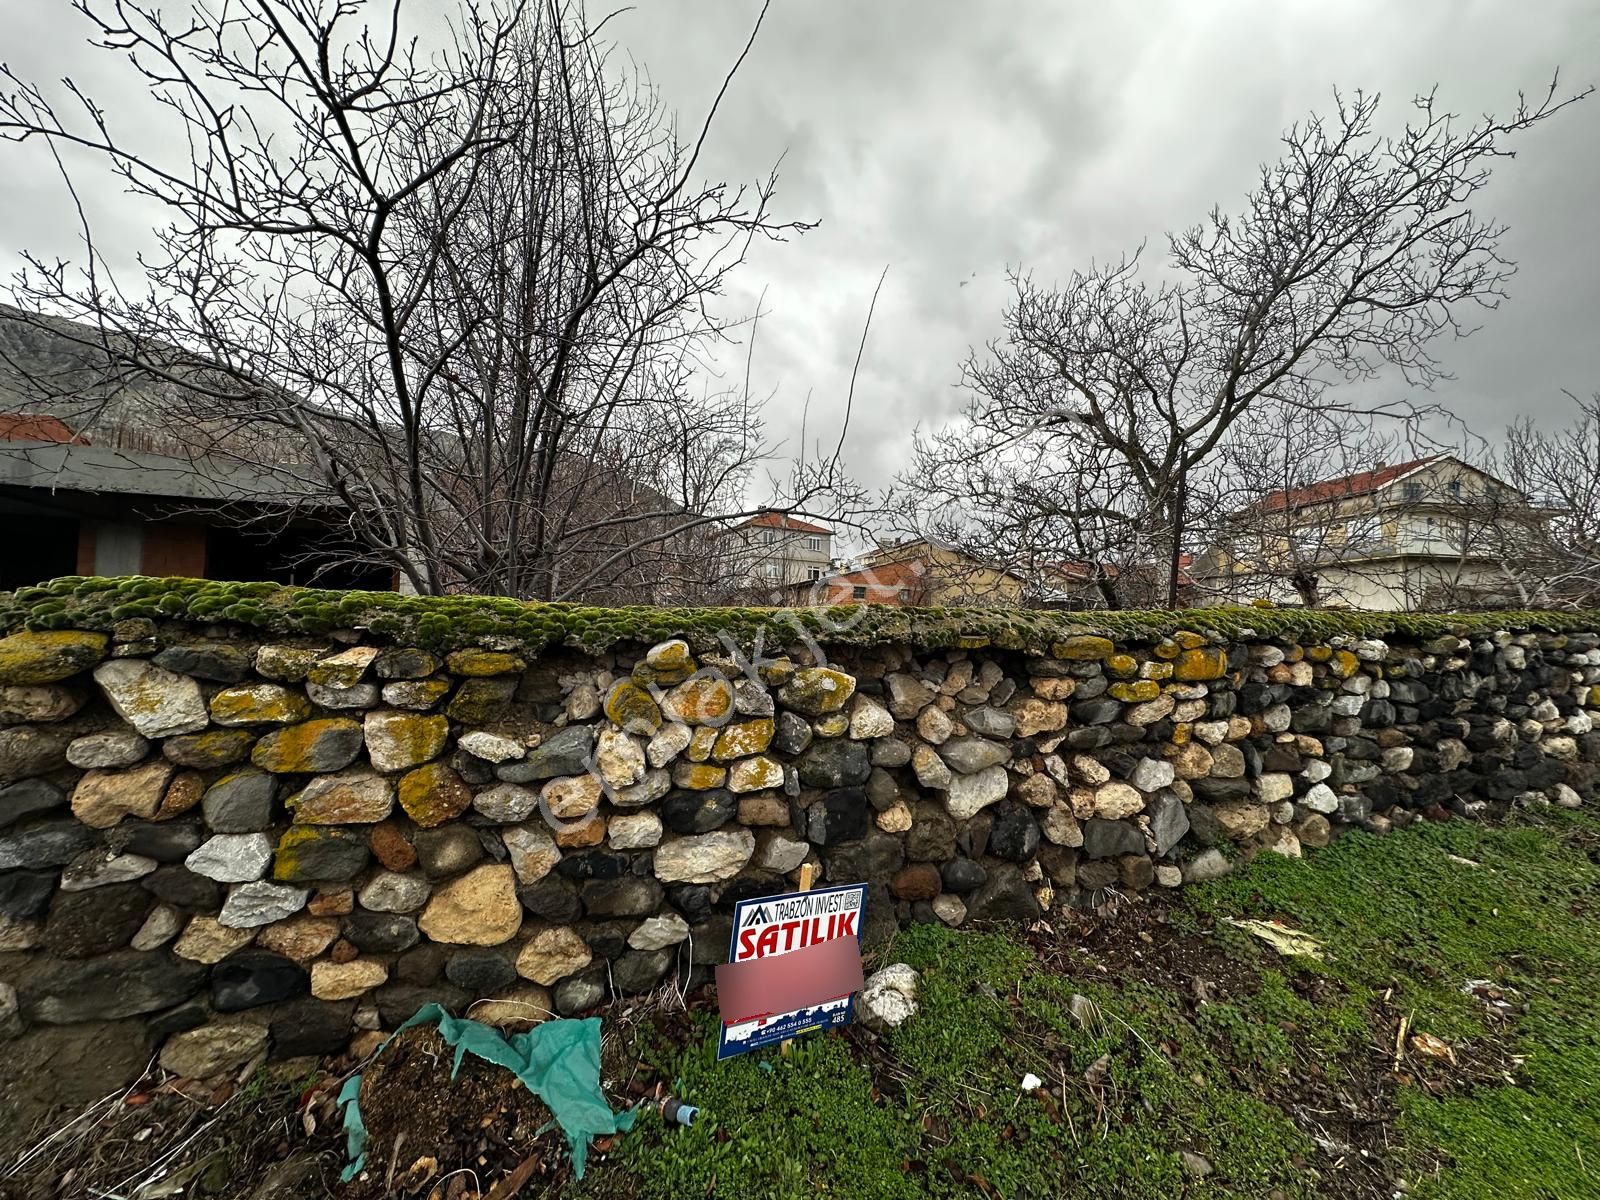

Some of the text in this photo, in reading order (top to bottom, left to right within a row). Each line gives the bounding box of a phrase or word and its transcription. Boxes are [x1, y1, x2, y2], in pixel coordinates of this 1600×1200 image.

[815, 893, 844, 916] INVEST
[738, 911, 857, 960] SATILIK
[776, 1024, 787, 1032] 462
[802, 1017, 813, 1025] 555
[832, 1014, 845, 1024] 485
